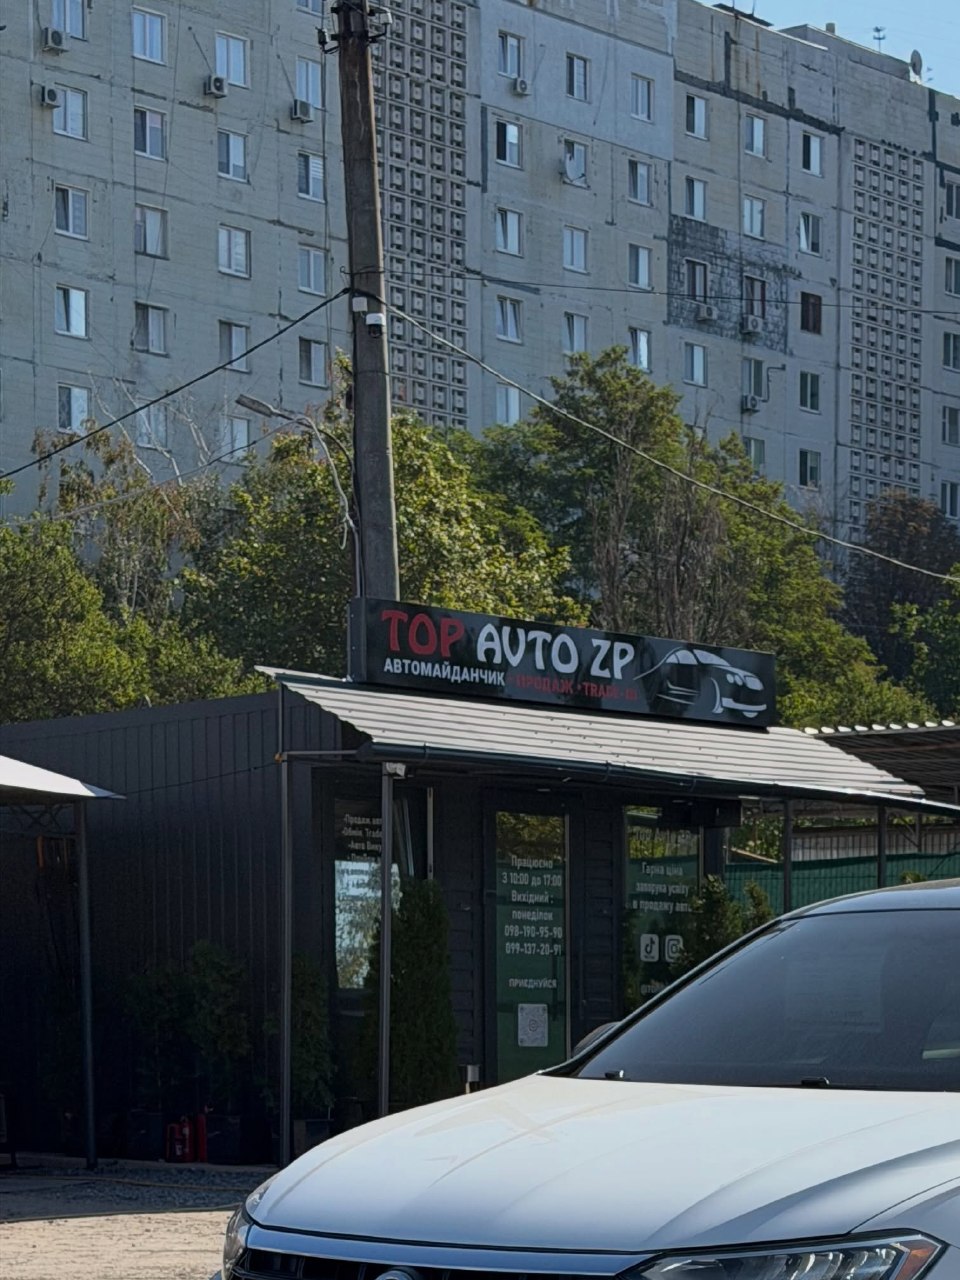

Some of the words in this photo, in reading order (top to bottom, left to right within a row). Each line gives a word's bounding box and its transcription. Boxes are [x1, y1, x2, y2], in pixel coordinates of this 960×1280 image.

[382, 610, 465, 657] TOP
[477, 623, 579, 674] AVTO
[590, 638, 635, 680] ZP
[384, 657, 505, 686] АВТОМАЙДАНЧИК
[511, 854, 554, 869] Працюємо
[641, 862, 665, 877] Гарна
[666, 864, 684, 877] ціна
[510, 872, 529, 885] 10:00
[531, 876, 542, 887] до
[543, 874, 562, 887] 17:00
[635, 882, 667, 895] запорука
[639, 900, 673, 914] продажу
[512, 909, 553, 921] понеділок
[504, 925, 563, 939] 098-190-95-90
[505, 943, 562, 955] 099-137-20-91
